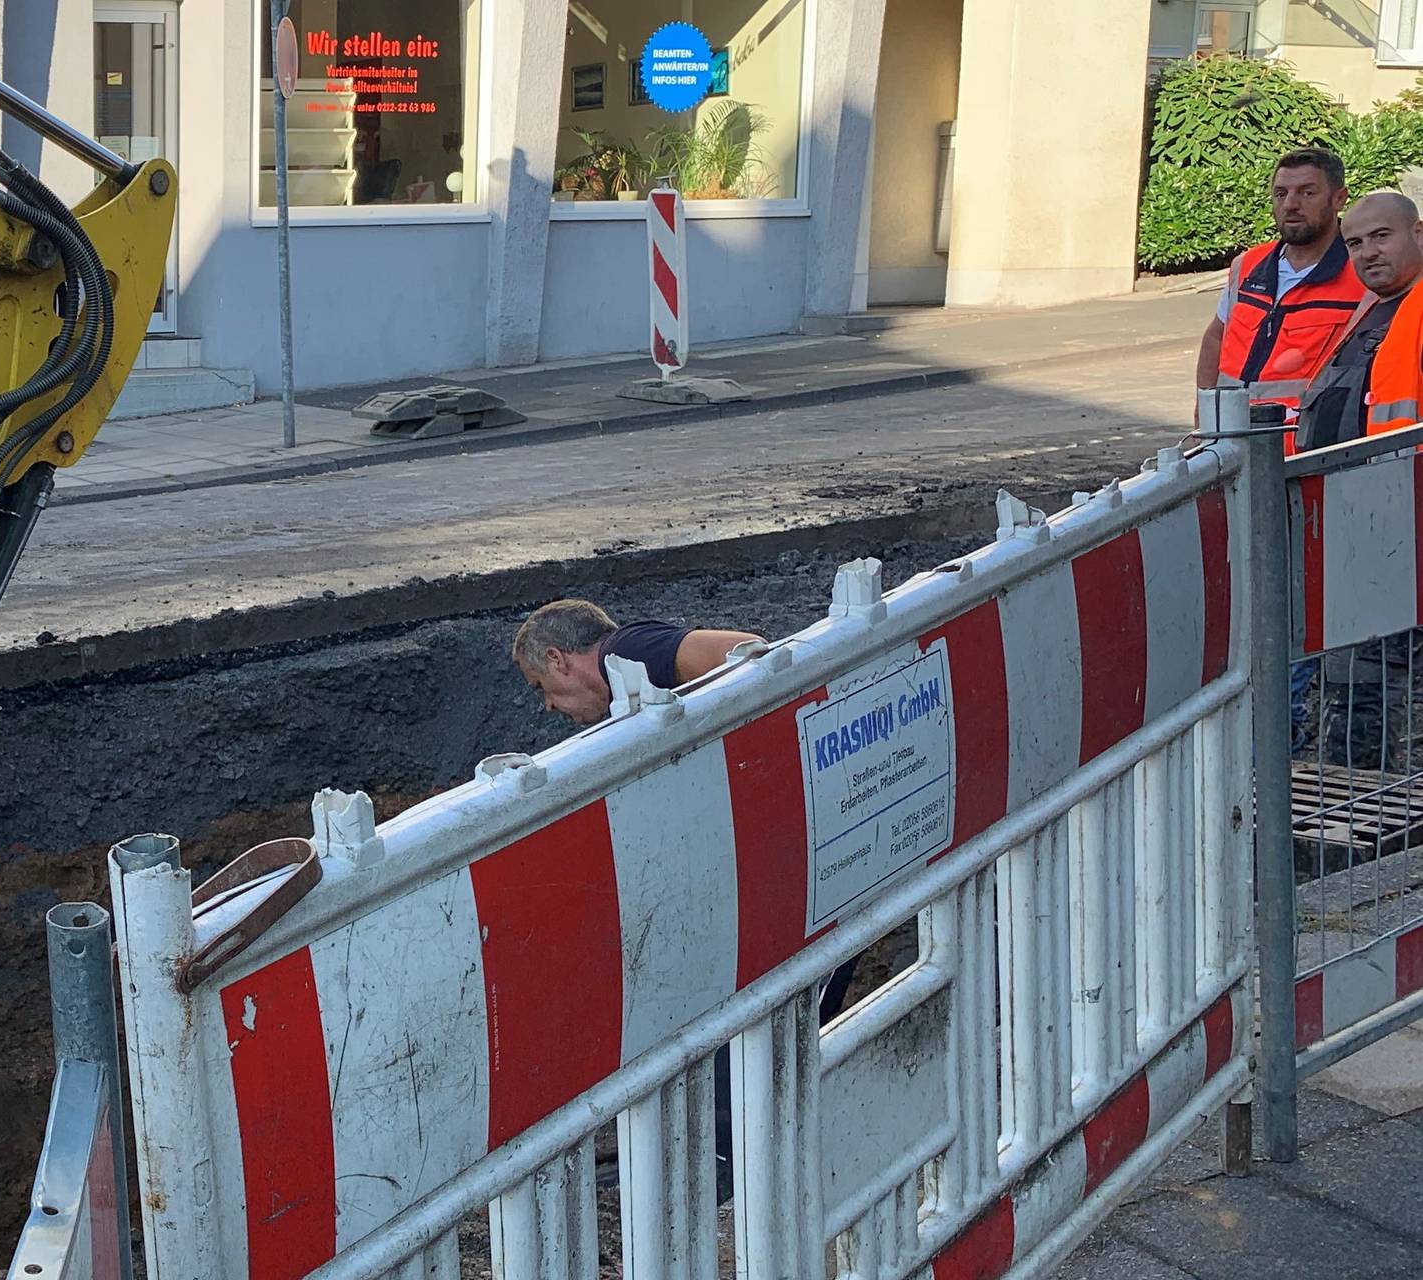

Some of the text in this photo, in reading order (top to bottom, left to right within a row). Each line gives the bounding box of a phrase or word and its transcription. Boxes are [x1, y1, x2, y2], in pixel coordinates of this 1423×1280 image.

[307, 30, 438, 58] Wir stellen ein:
[653, 49, 694, 59] BEAMTEN-
[326, 64, 418, 78] Vertriebsmitarbeiter im
[652, 61, 709, 72] ANWÄRTER/IN
[325, 80, 418, 94] elltenverhältnis!
[652, 76, 697, 85] INFOS HIER
[815, 677, 940, 772] KRASNIQI GmbH
